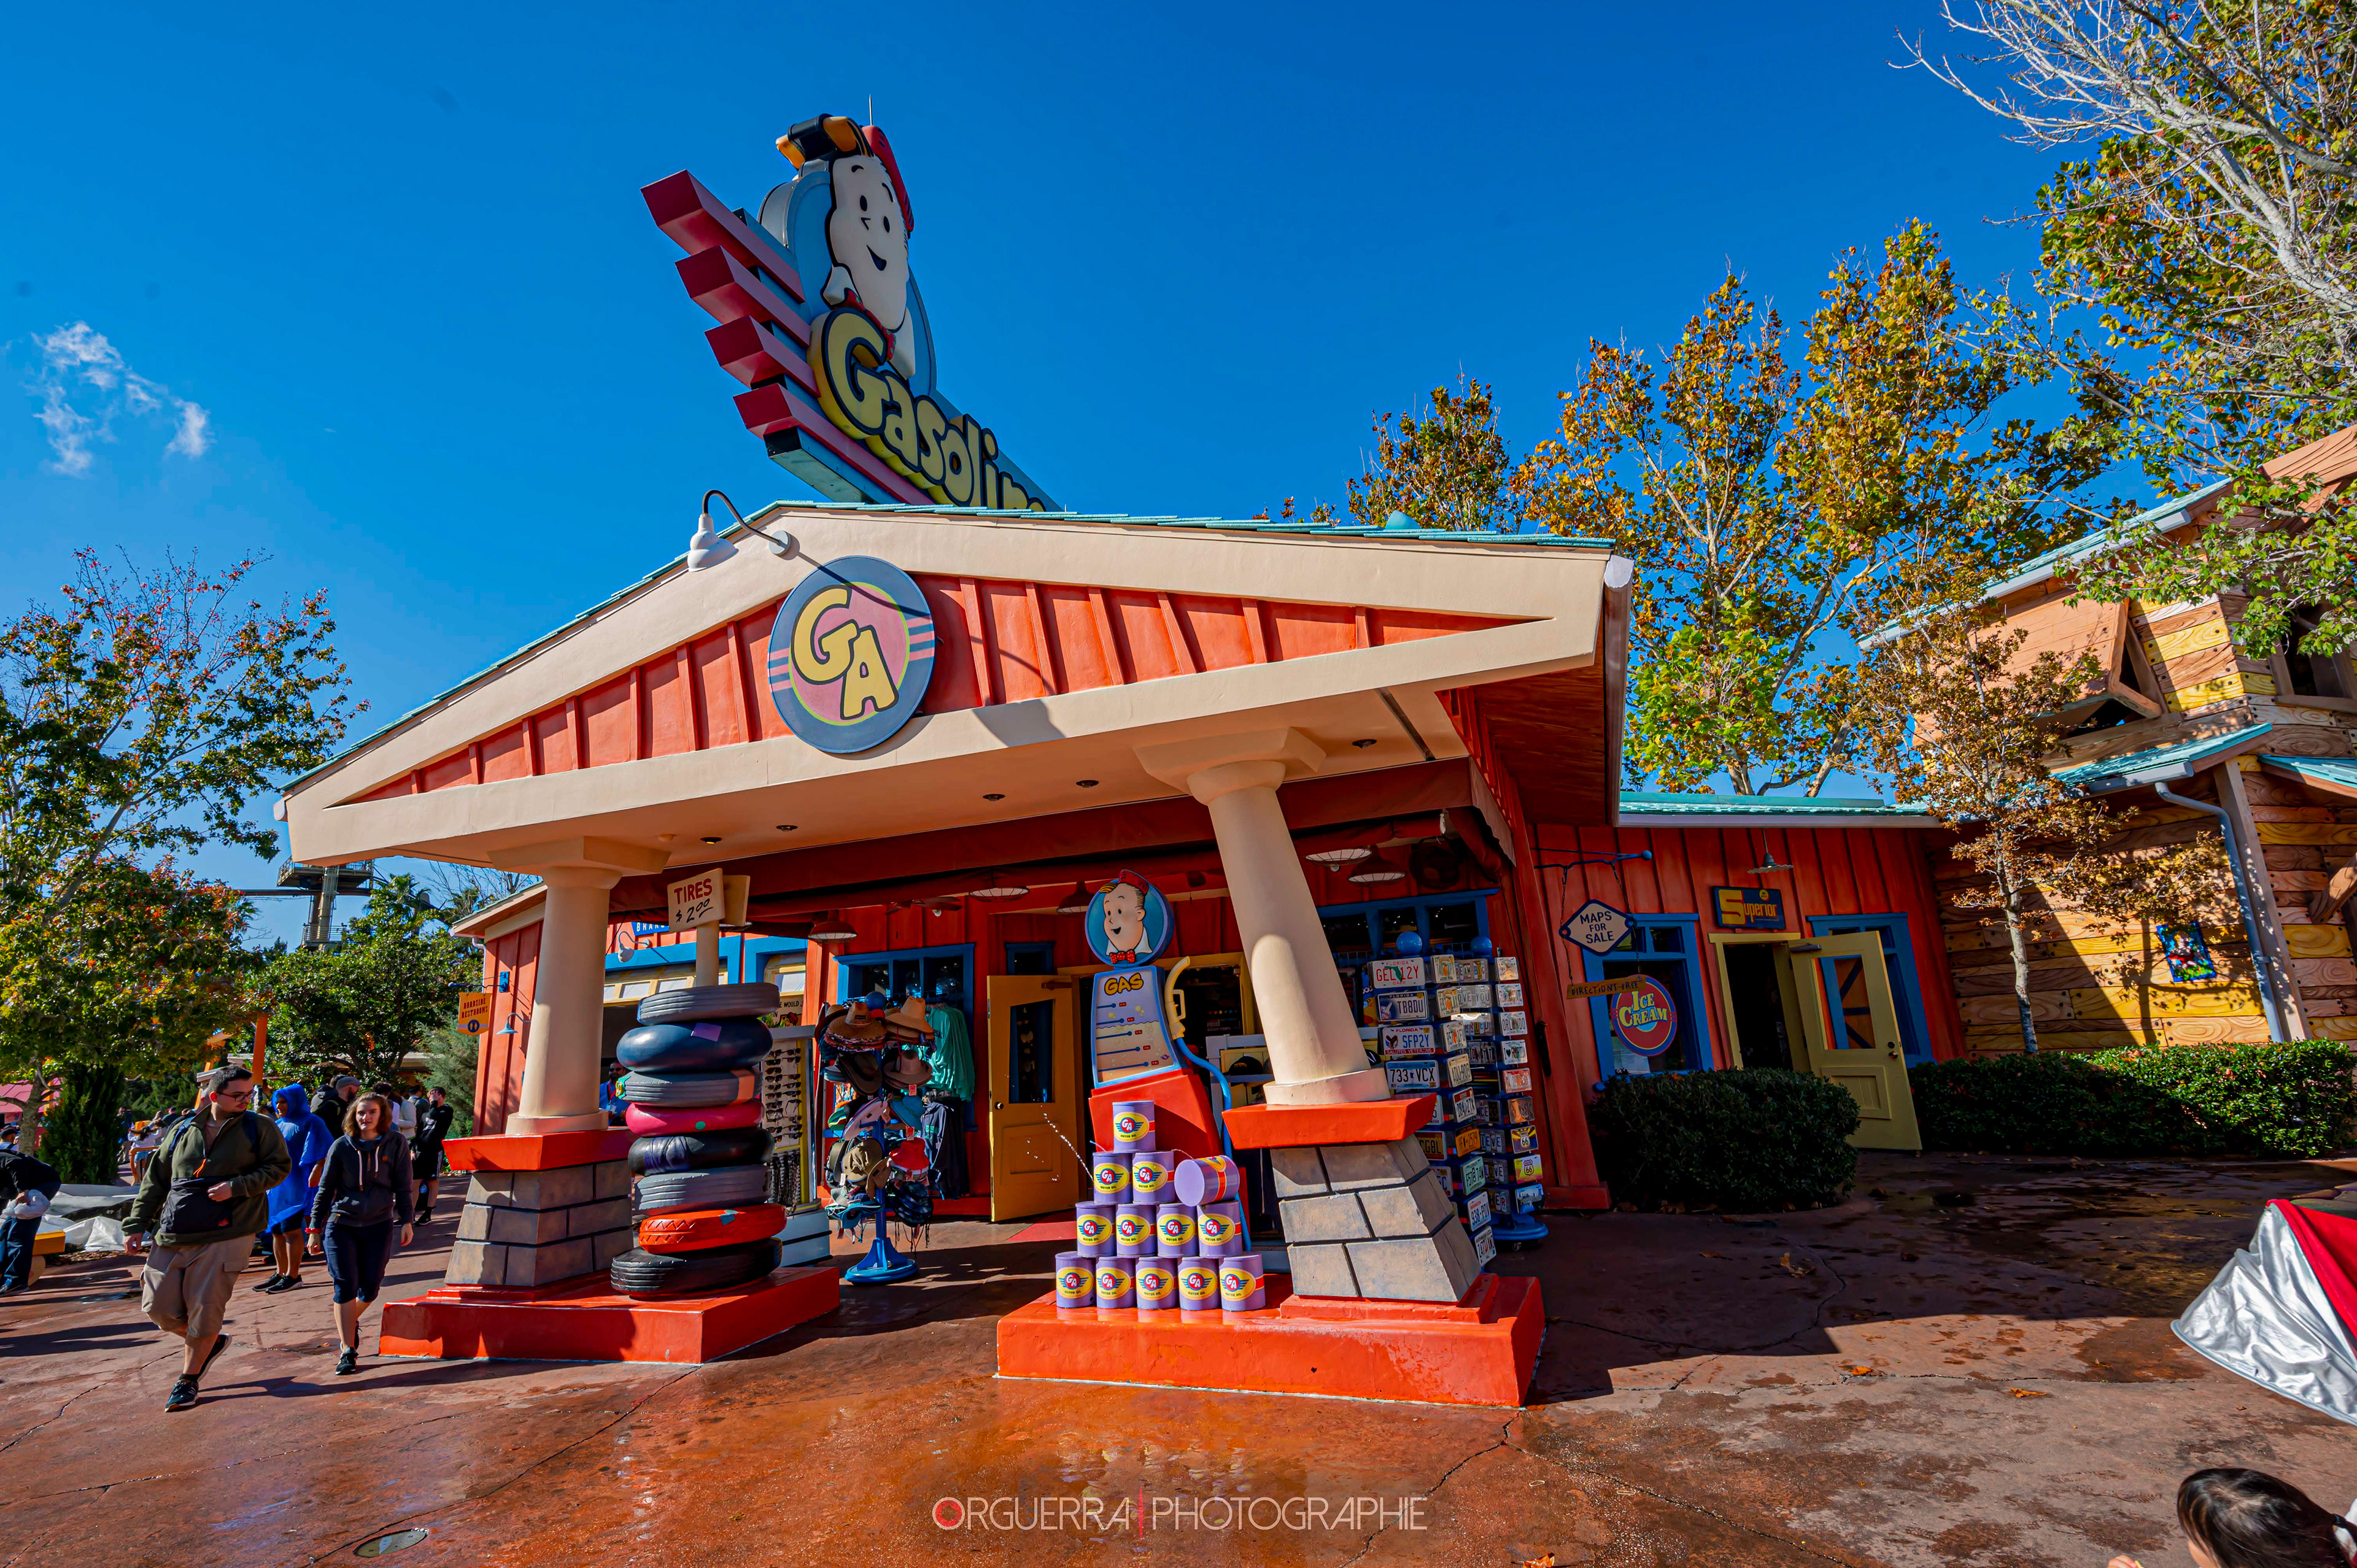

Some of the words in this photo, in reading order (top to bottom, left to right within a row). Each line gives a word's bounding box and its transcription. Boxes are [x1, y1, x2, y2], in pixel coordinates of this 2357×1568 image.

[820, 307, 1046, 511] Gasolin
[791, 584, 899, 720] GA
[674, 878, 712, 905] TIRES
[1719, 889, 1778, 925] Superior
[1580, 911, 1612, 924] MAPS
[1589, 923, 1606, 932] FOR
[1585, 931, 1614, 944] SALE
[1376, 968, 1396, 981] GEL
[1400, 965, 1418, 980] 12Y
[1104, 973, 1144, 995] GAS
[1476, 992, 1489, 1002] YOU
[463, 998, 486, 1010] ROADSIDE
[462, 1006, 488, 1019] RESTROOMS
[1390, 1069, 1409, 1083] 733
[1416, 1068, 1435, 1082] VCX
[1121, 1119, 1132, 1130] GA
[1522, 1137, 1529, 1146] 66
[1102, 1170, 1112, 1182] GA
[1140, 1168, 1150, 1181] GA
[1084, 1222, 1094, 1234] GA
[1122, 1221, 1132, 1234] GA
[1167, 1221, 1178, 1234] GA
[1206, 1221, 1217, 1234] GA
[1066, 1275, 1077, 1287] GA
[1102, 1275, 1113, 1288] GA
[1145, 1275, 1156, 1288] GA
[1189, 1275, 1201, 1288] GA
[1226, 1276, 1237, 1289] GA
